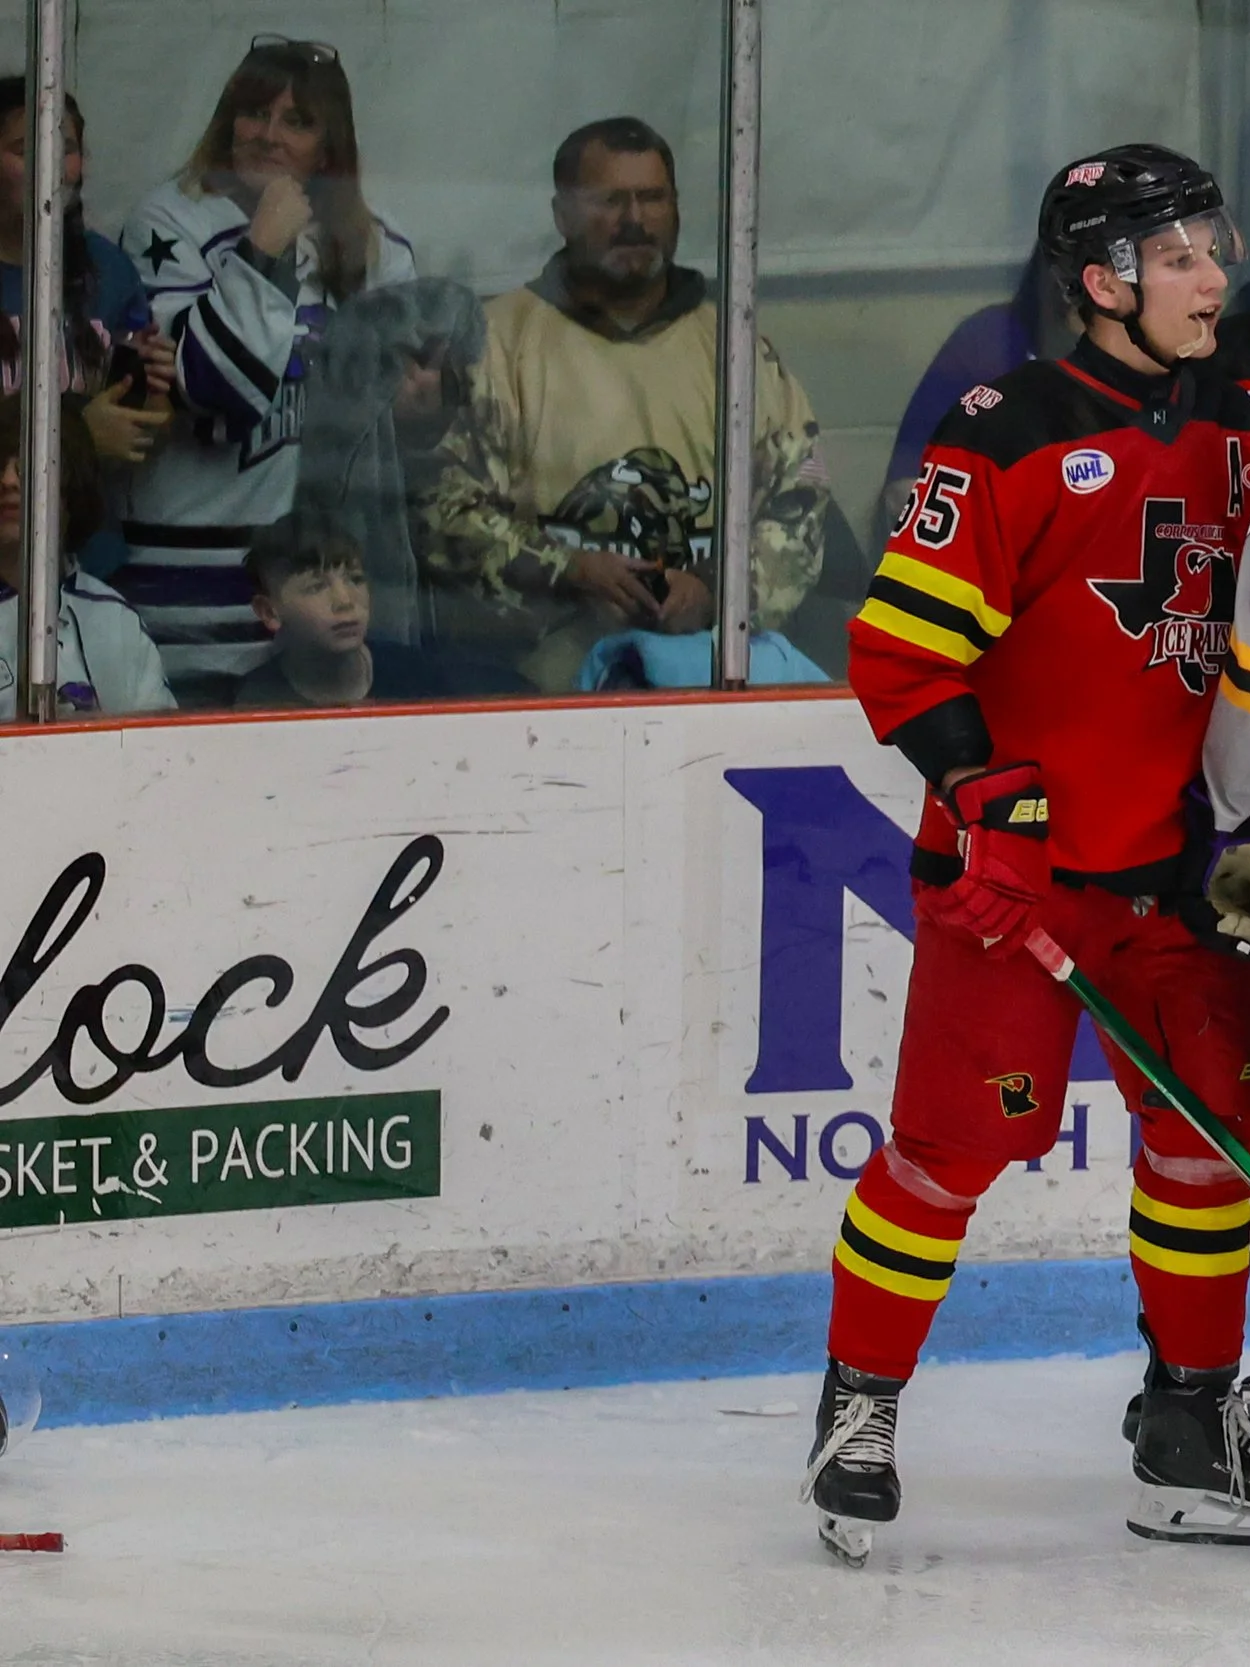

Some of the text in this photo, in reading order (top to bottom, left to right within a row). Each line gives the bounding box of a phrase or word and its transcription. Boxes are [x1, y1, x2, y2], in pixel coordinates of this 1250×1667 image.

[1066, 459, 1108, 484] NAHL
[133, 1133, 169, 1188] &
[191, 1115, 412, 1184] PACKING
